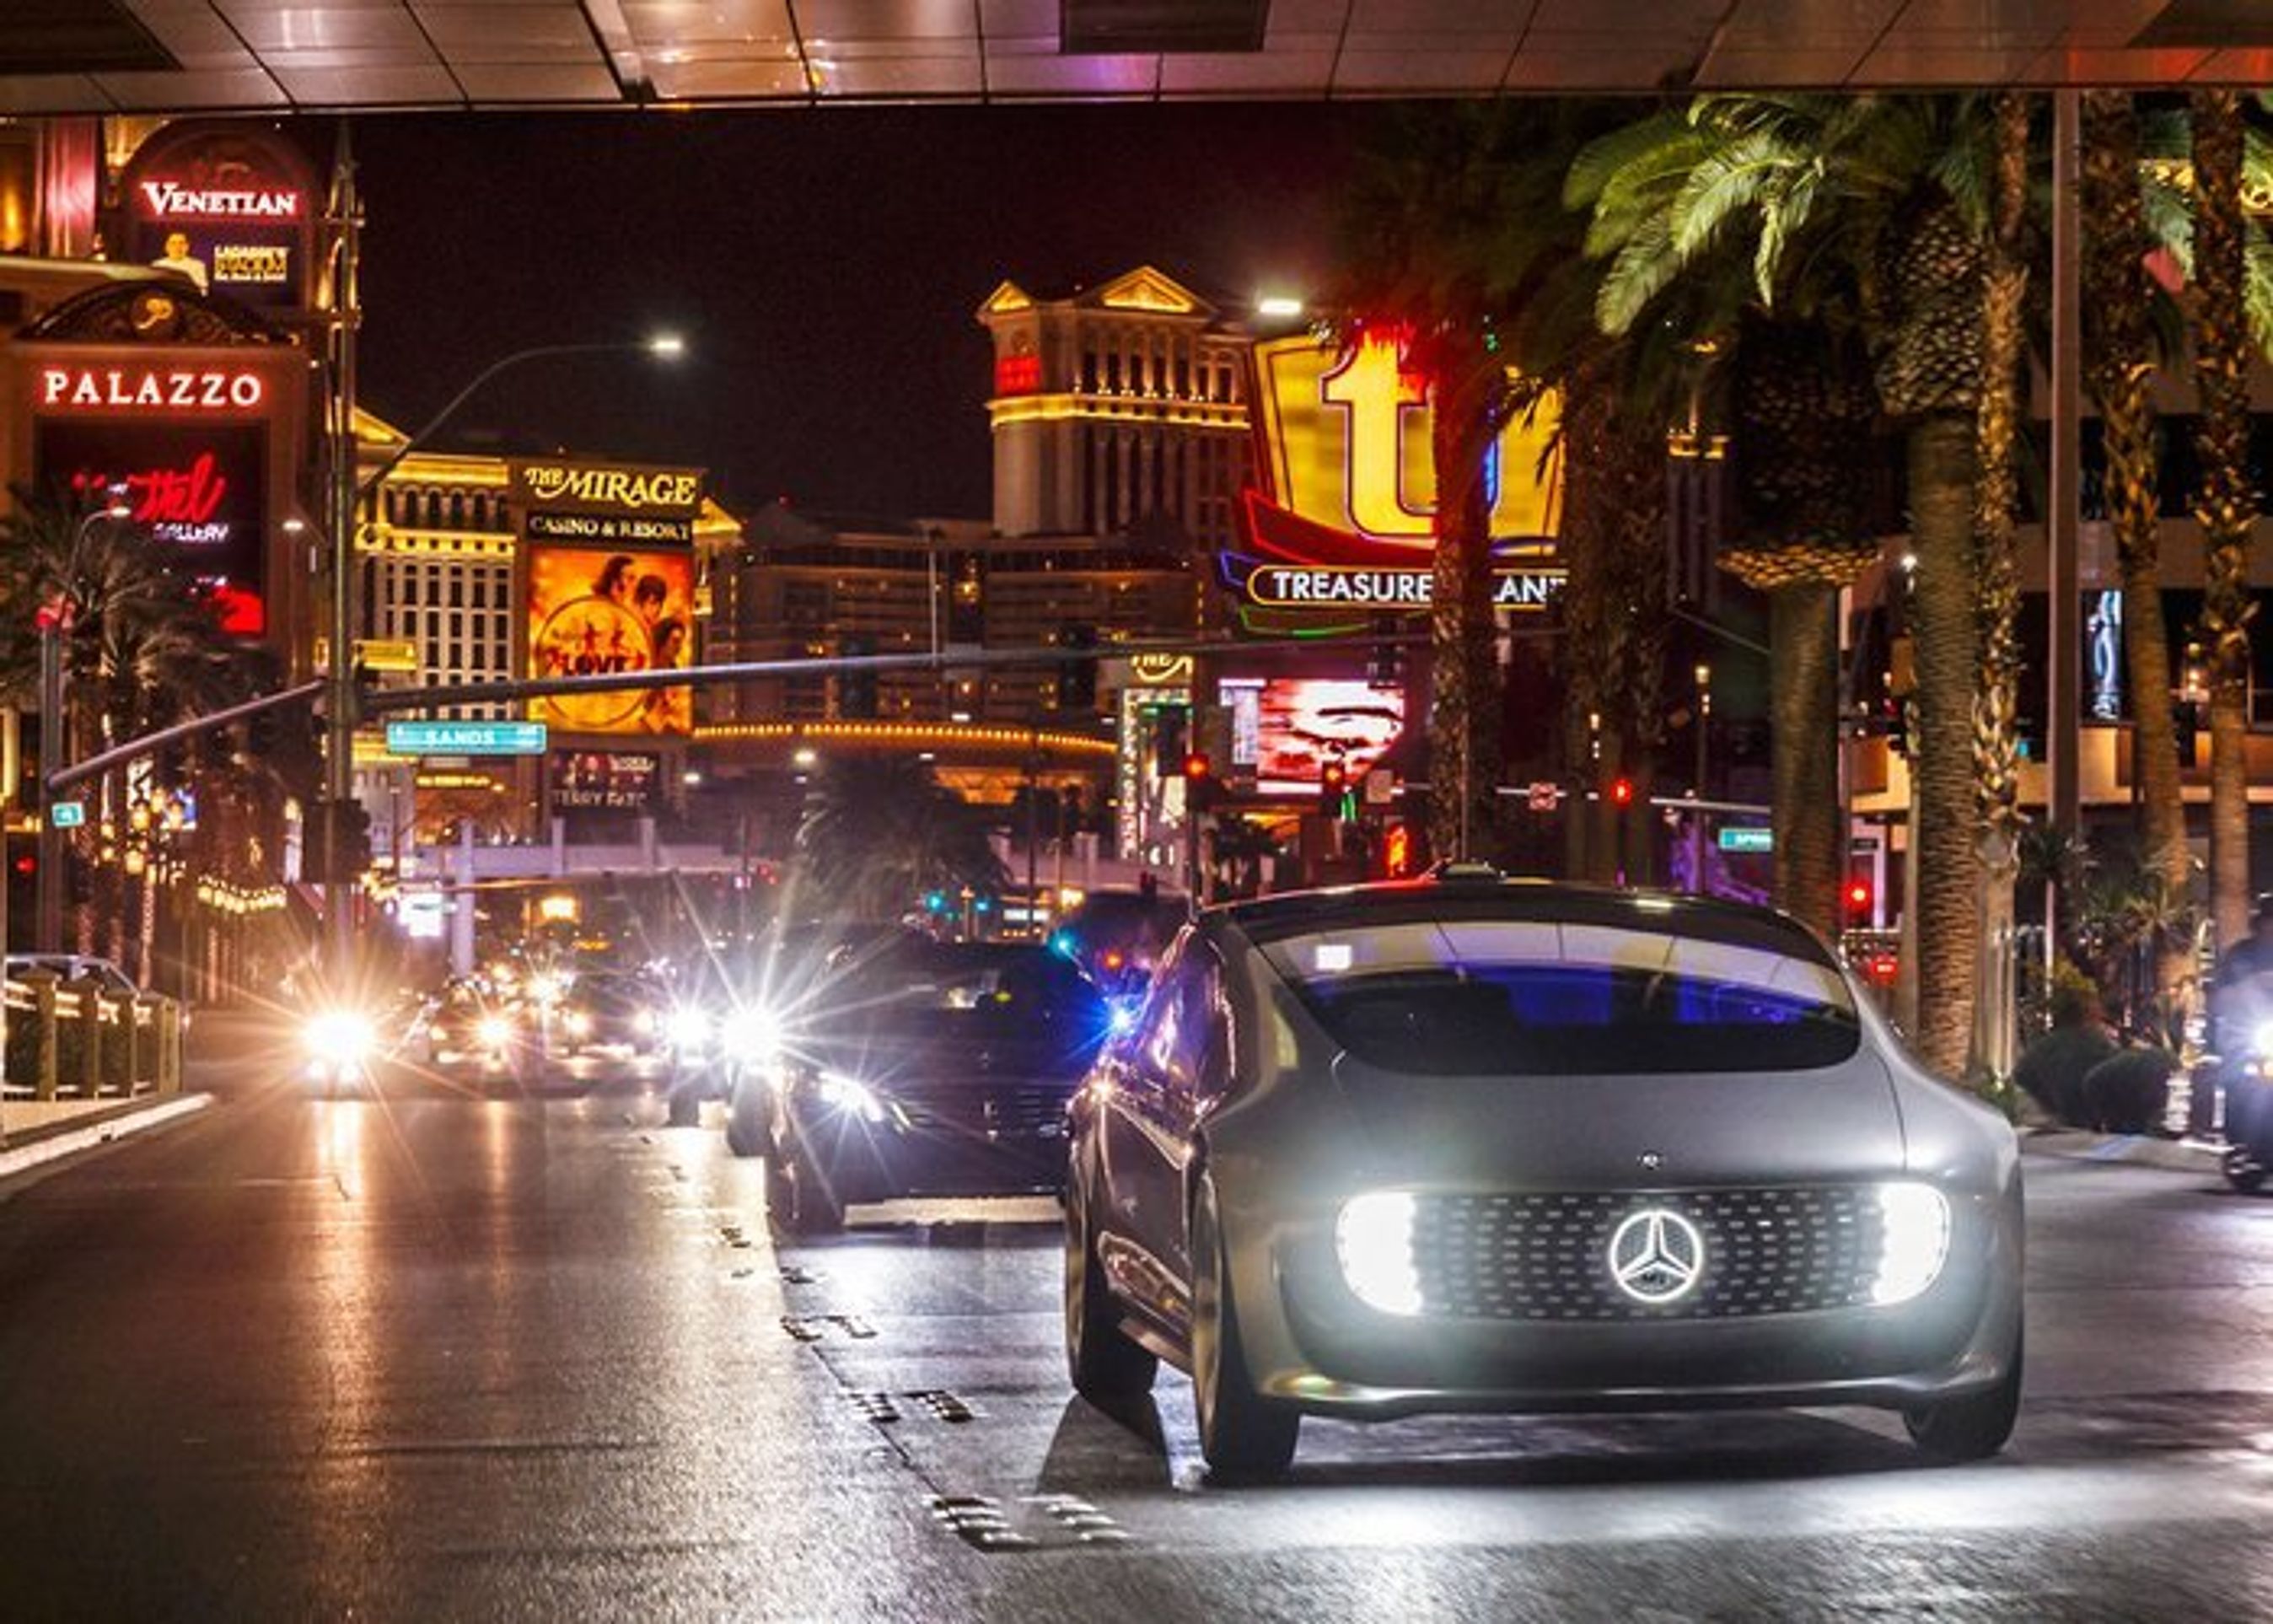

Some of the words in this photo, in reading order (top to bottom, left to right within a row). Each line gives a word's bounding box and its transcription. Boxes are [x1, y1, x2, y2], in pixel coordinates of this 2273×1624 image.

[141, 180, 297, 216] VENETIAN
[44, 369, 261, 406] PALAZZO
[524, 466, 564, 486] THE
[535, 470, 697, 508] MIRAGE
[529, 515, 599, 536] CASINO
[601, 520, 615, 537] &
[620, 520, 690, 540] RESORT
[1271, 571, 1432, 602] TREASURE
[425, 729, 496, 745] SANDS
